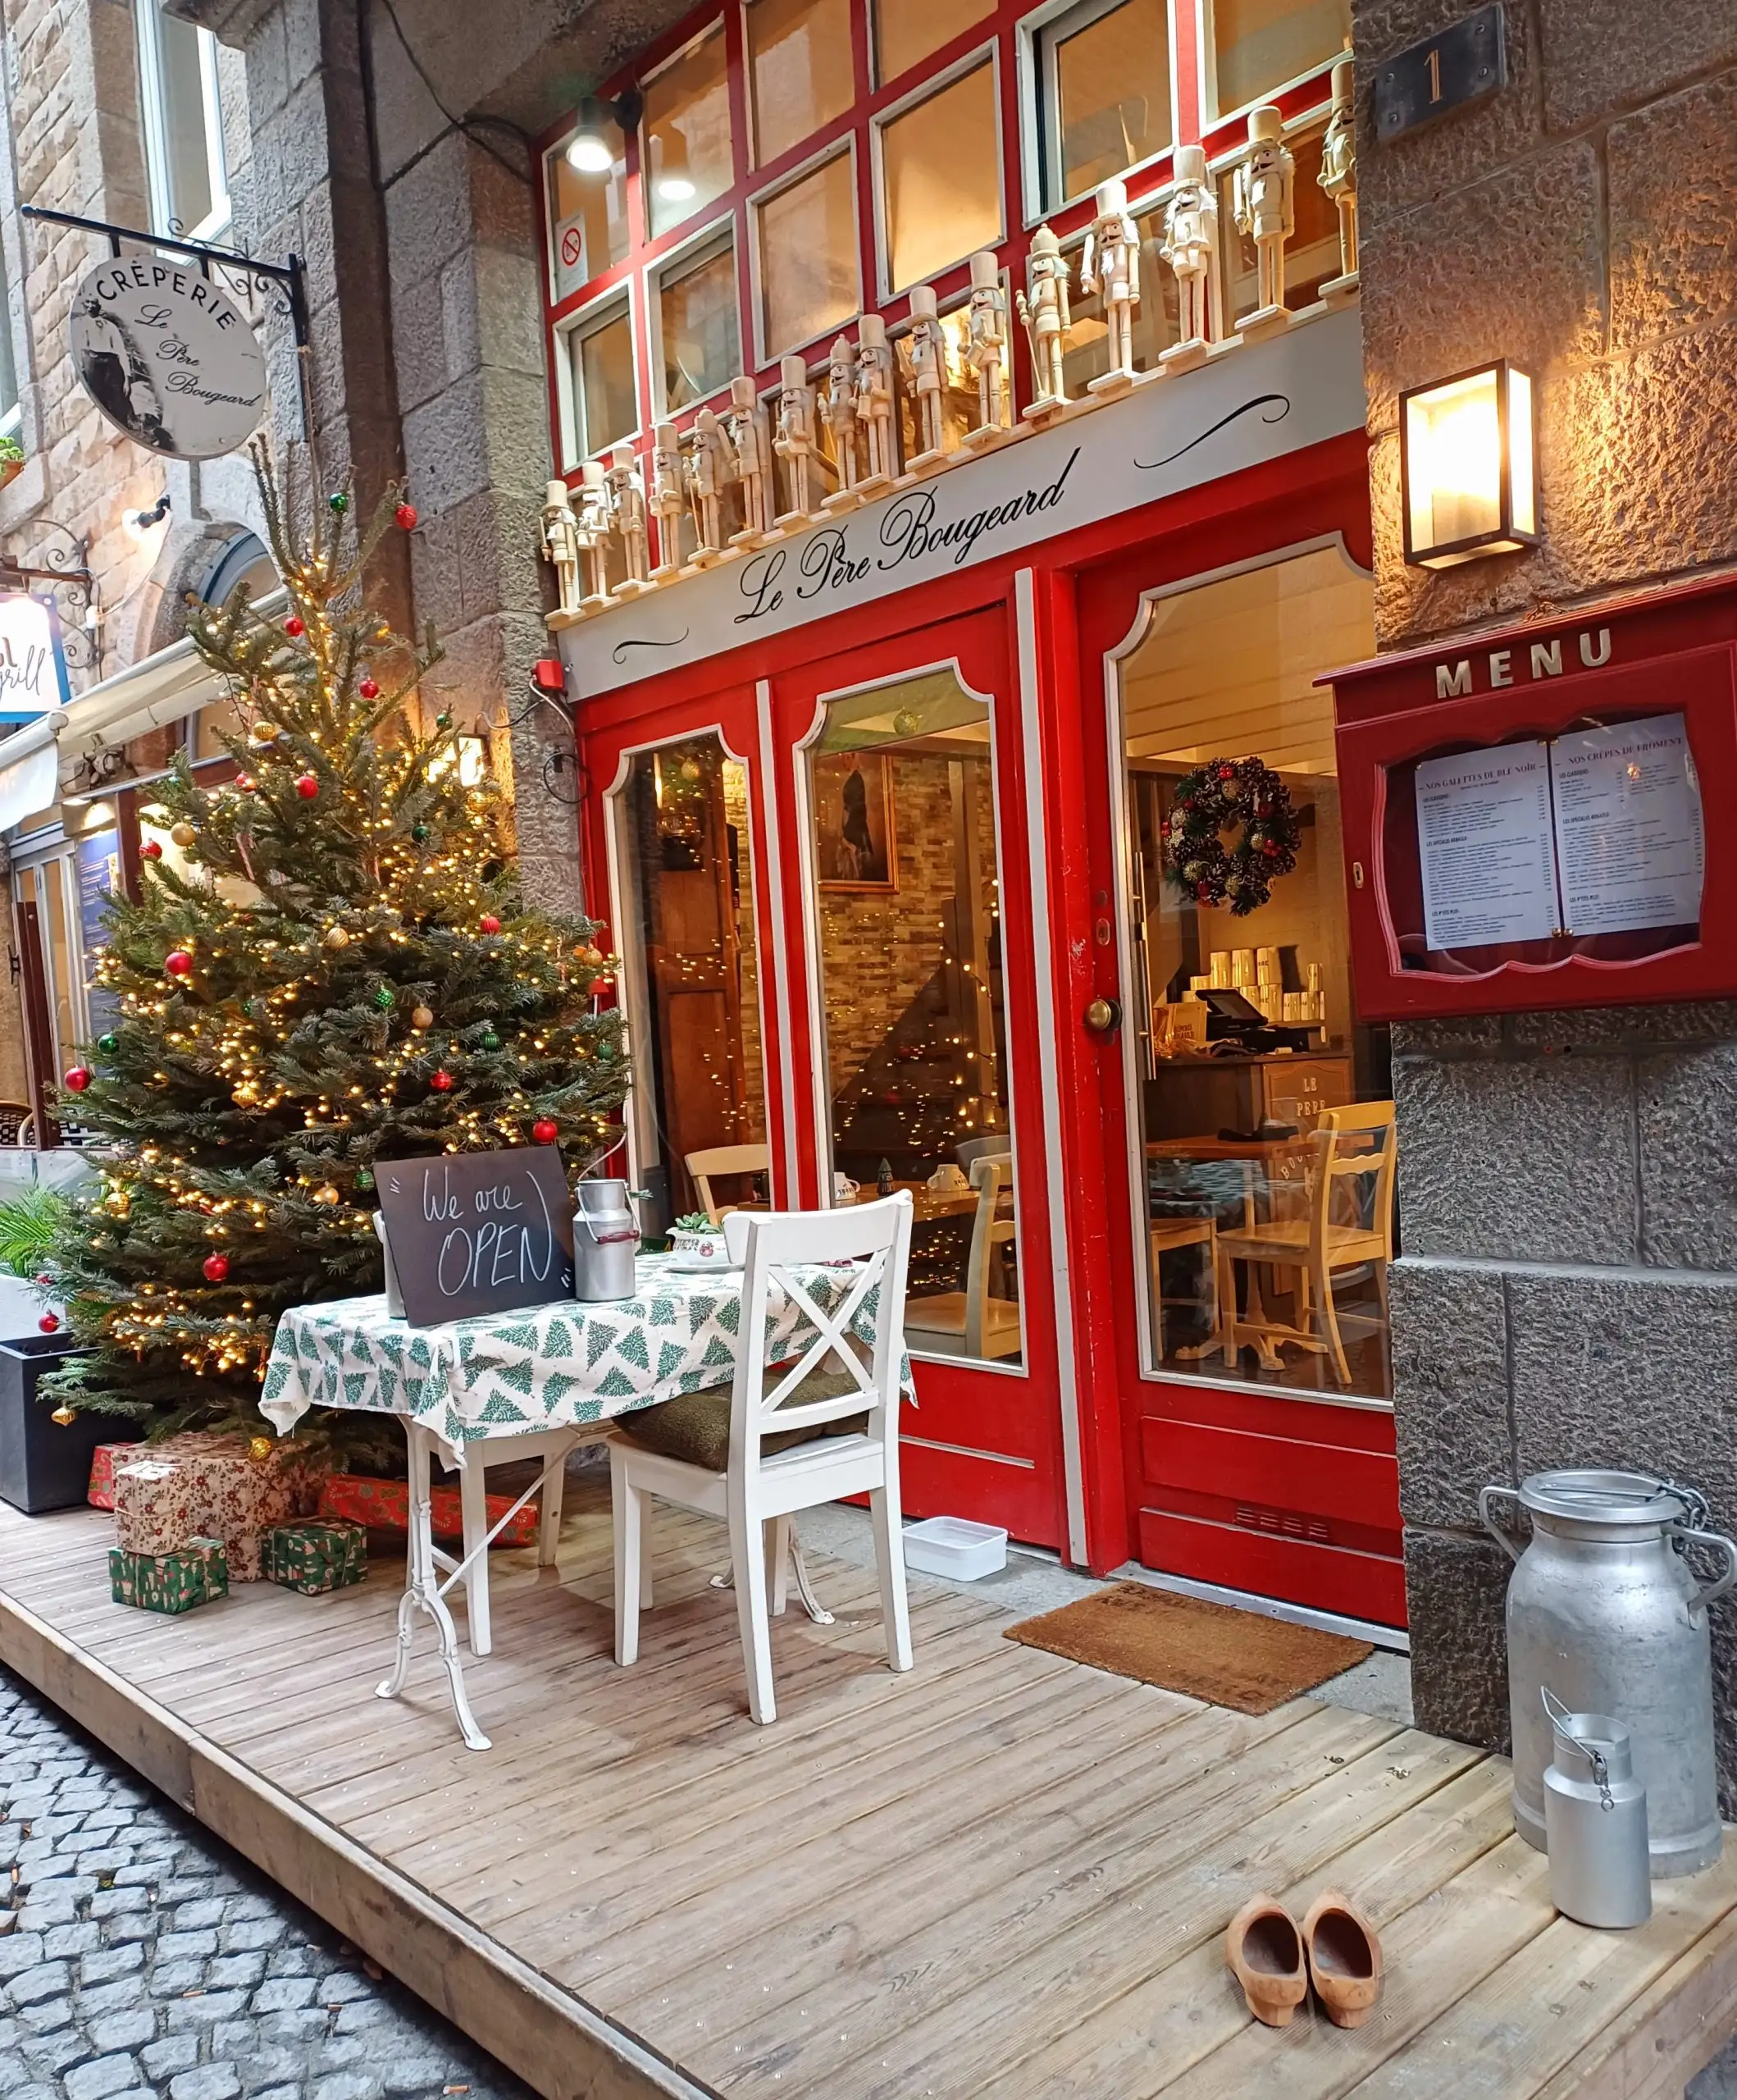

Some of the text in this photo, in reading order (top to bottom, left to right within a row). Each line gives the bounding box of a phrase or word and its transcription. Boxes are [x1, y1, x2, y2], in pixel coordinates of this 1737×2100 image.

[1424, 49, 1443, 105] 1
[96, 260, 237, 331] CRÊPERIE
[134, 304, 173, 329] Le
[156, 339, 201, 368] Père
[165, 371, 263, 409] Bougeard
[733, 446, 1083, 624] Le Père Bougeard
[1435, 628, 1612, 699] MENU
[1302, 1077, 1318, 1093] LE
[423, 1165, 523, 1221] We are
[438, 1171, 553, 1296] OPEN
